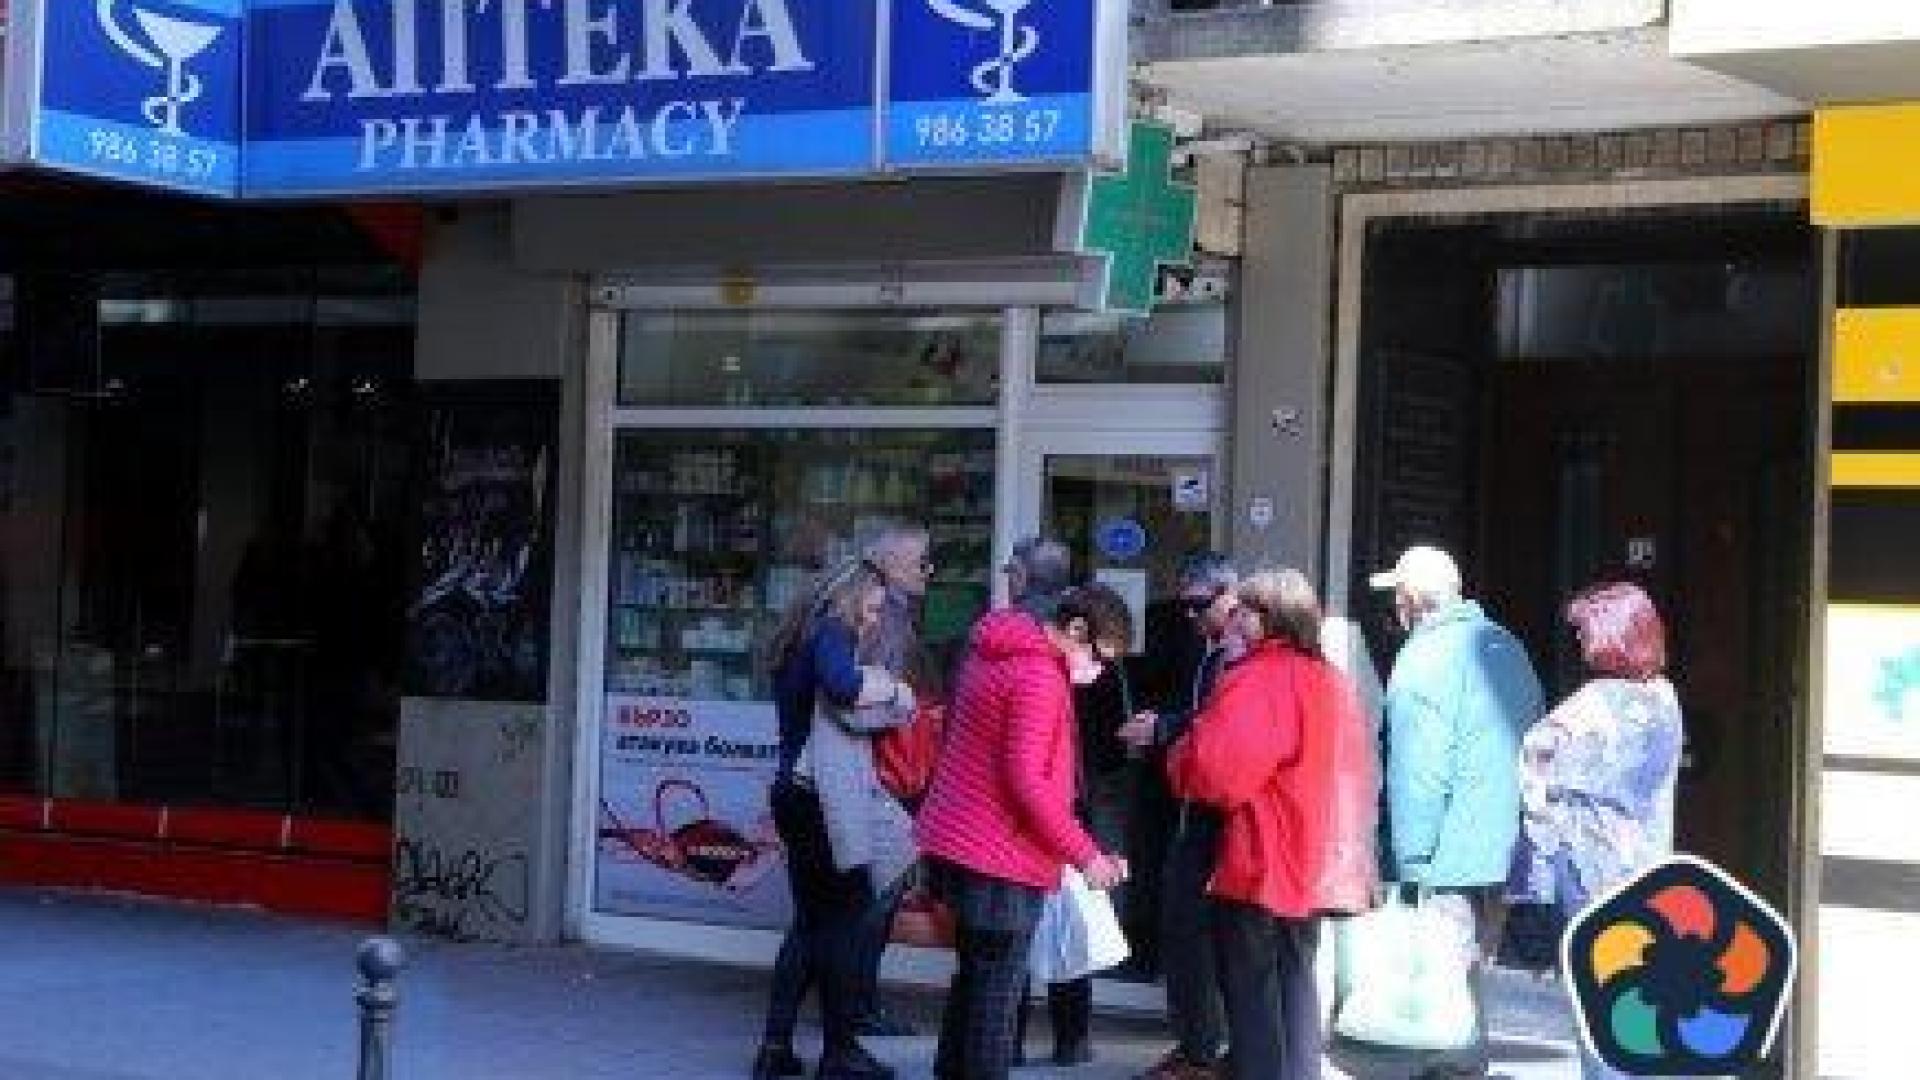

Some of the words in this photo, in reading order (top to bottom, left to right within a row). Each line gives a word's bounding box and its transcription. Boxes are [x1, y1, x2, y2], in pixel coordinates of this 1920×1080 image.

[302, 0, 815, 100] АПТЕКА
[87, 128, 138, 163] 986
[145, 139, 179, 172] 38
[187, 148, 218, 177] 57
[357, 98, 746, 170] PHARMACY
[914, 115, 967, 147] 986
[976, 112, 1015, 143] 38
[1024, 109, 1061, 141] 57
